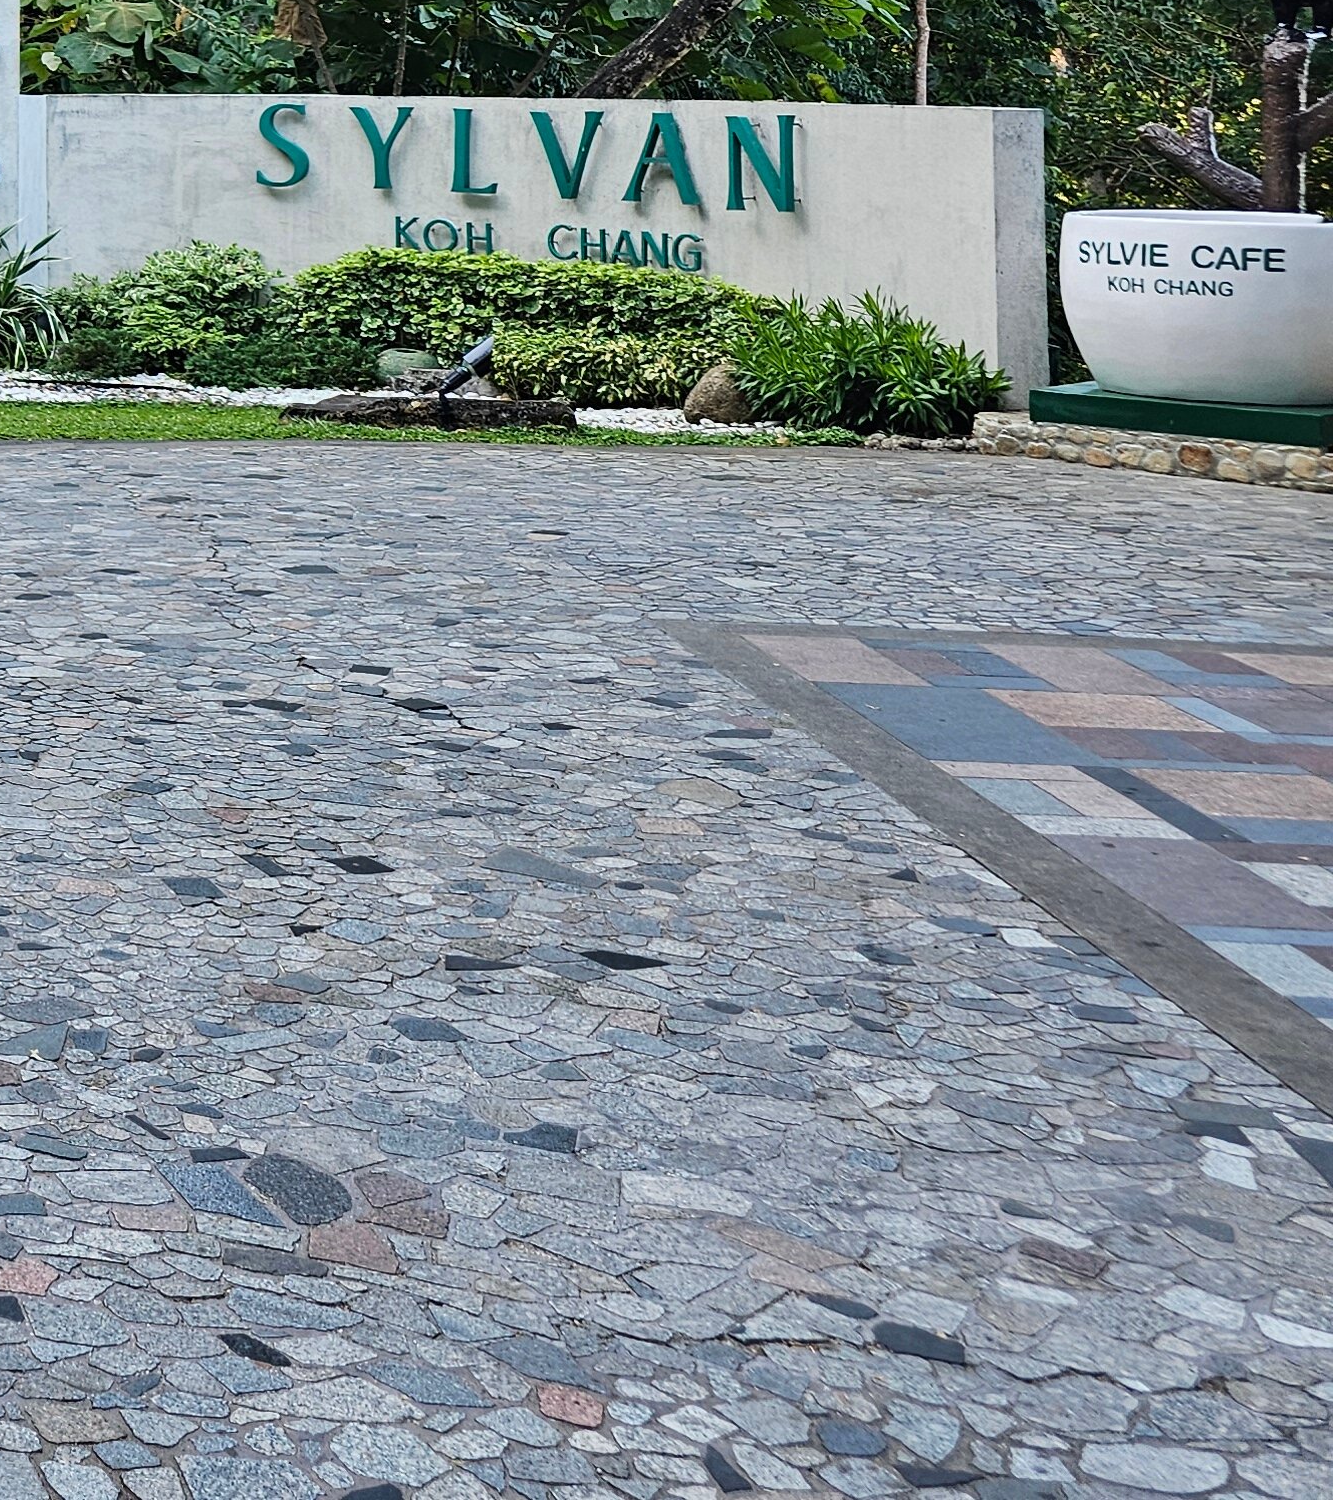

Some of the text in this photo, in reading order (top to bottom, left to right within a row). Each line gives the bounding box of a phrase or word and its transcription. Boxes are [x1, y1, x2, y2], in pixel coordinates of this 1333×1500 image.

[255, 103, 797, 213] SYLVAN
[394, 215, 703, 272] KOH CHANG
[1078, 240, 1287, 273] SYLVIE CAFE
[1107, 276, 1234, 297] KOH CHANG
